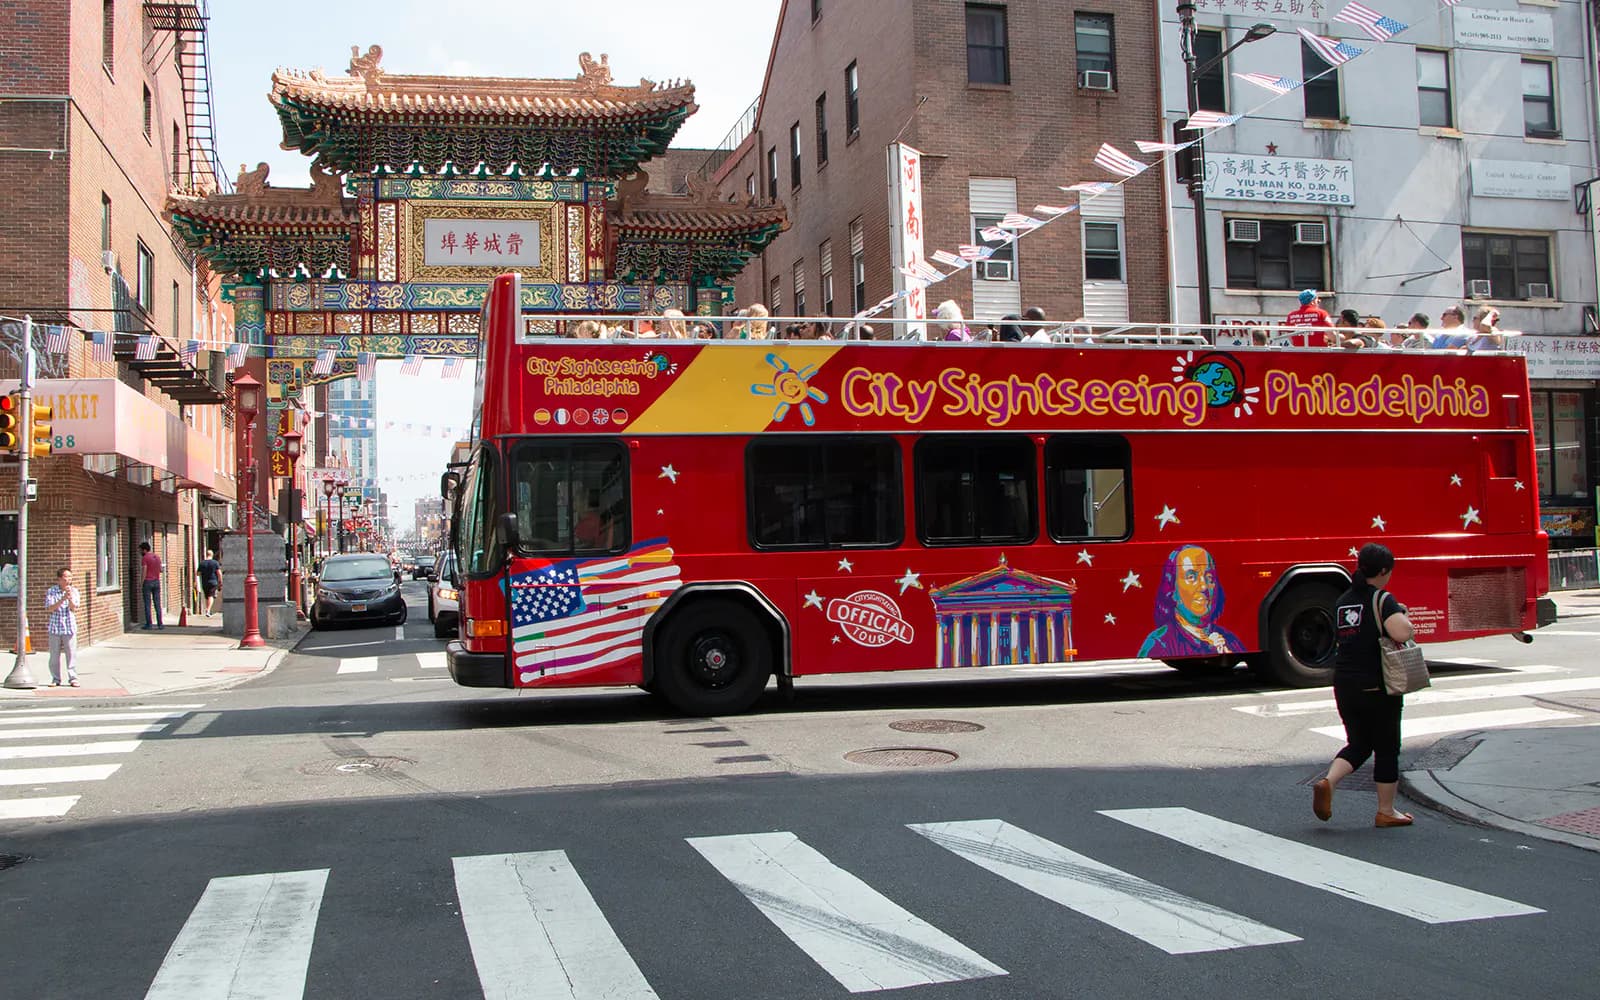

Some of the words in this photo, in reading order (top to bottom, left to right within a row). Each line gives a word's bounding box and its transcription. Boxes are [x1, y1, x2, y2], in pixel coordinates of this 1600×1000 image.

[1222, 157, 1349, 182] 高耀文牙醫診所
[1225, 188, 1350, 203] 215-629-2288
[1237, 179, 1284, 189] YIU-MAN
[1288, 182, 1305, 191] KO,
[1308, 182, 1340, 192] D.M.D.
[544, 377, 640, 397] Philadelphia
[1263, 368, 1491, 424] Philadelphia
[837, 604, 908, 641] OFFICIAL
[852, 626, 886, 644] TOUR
